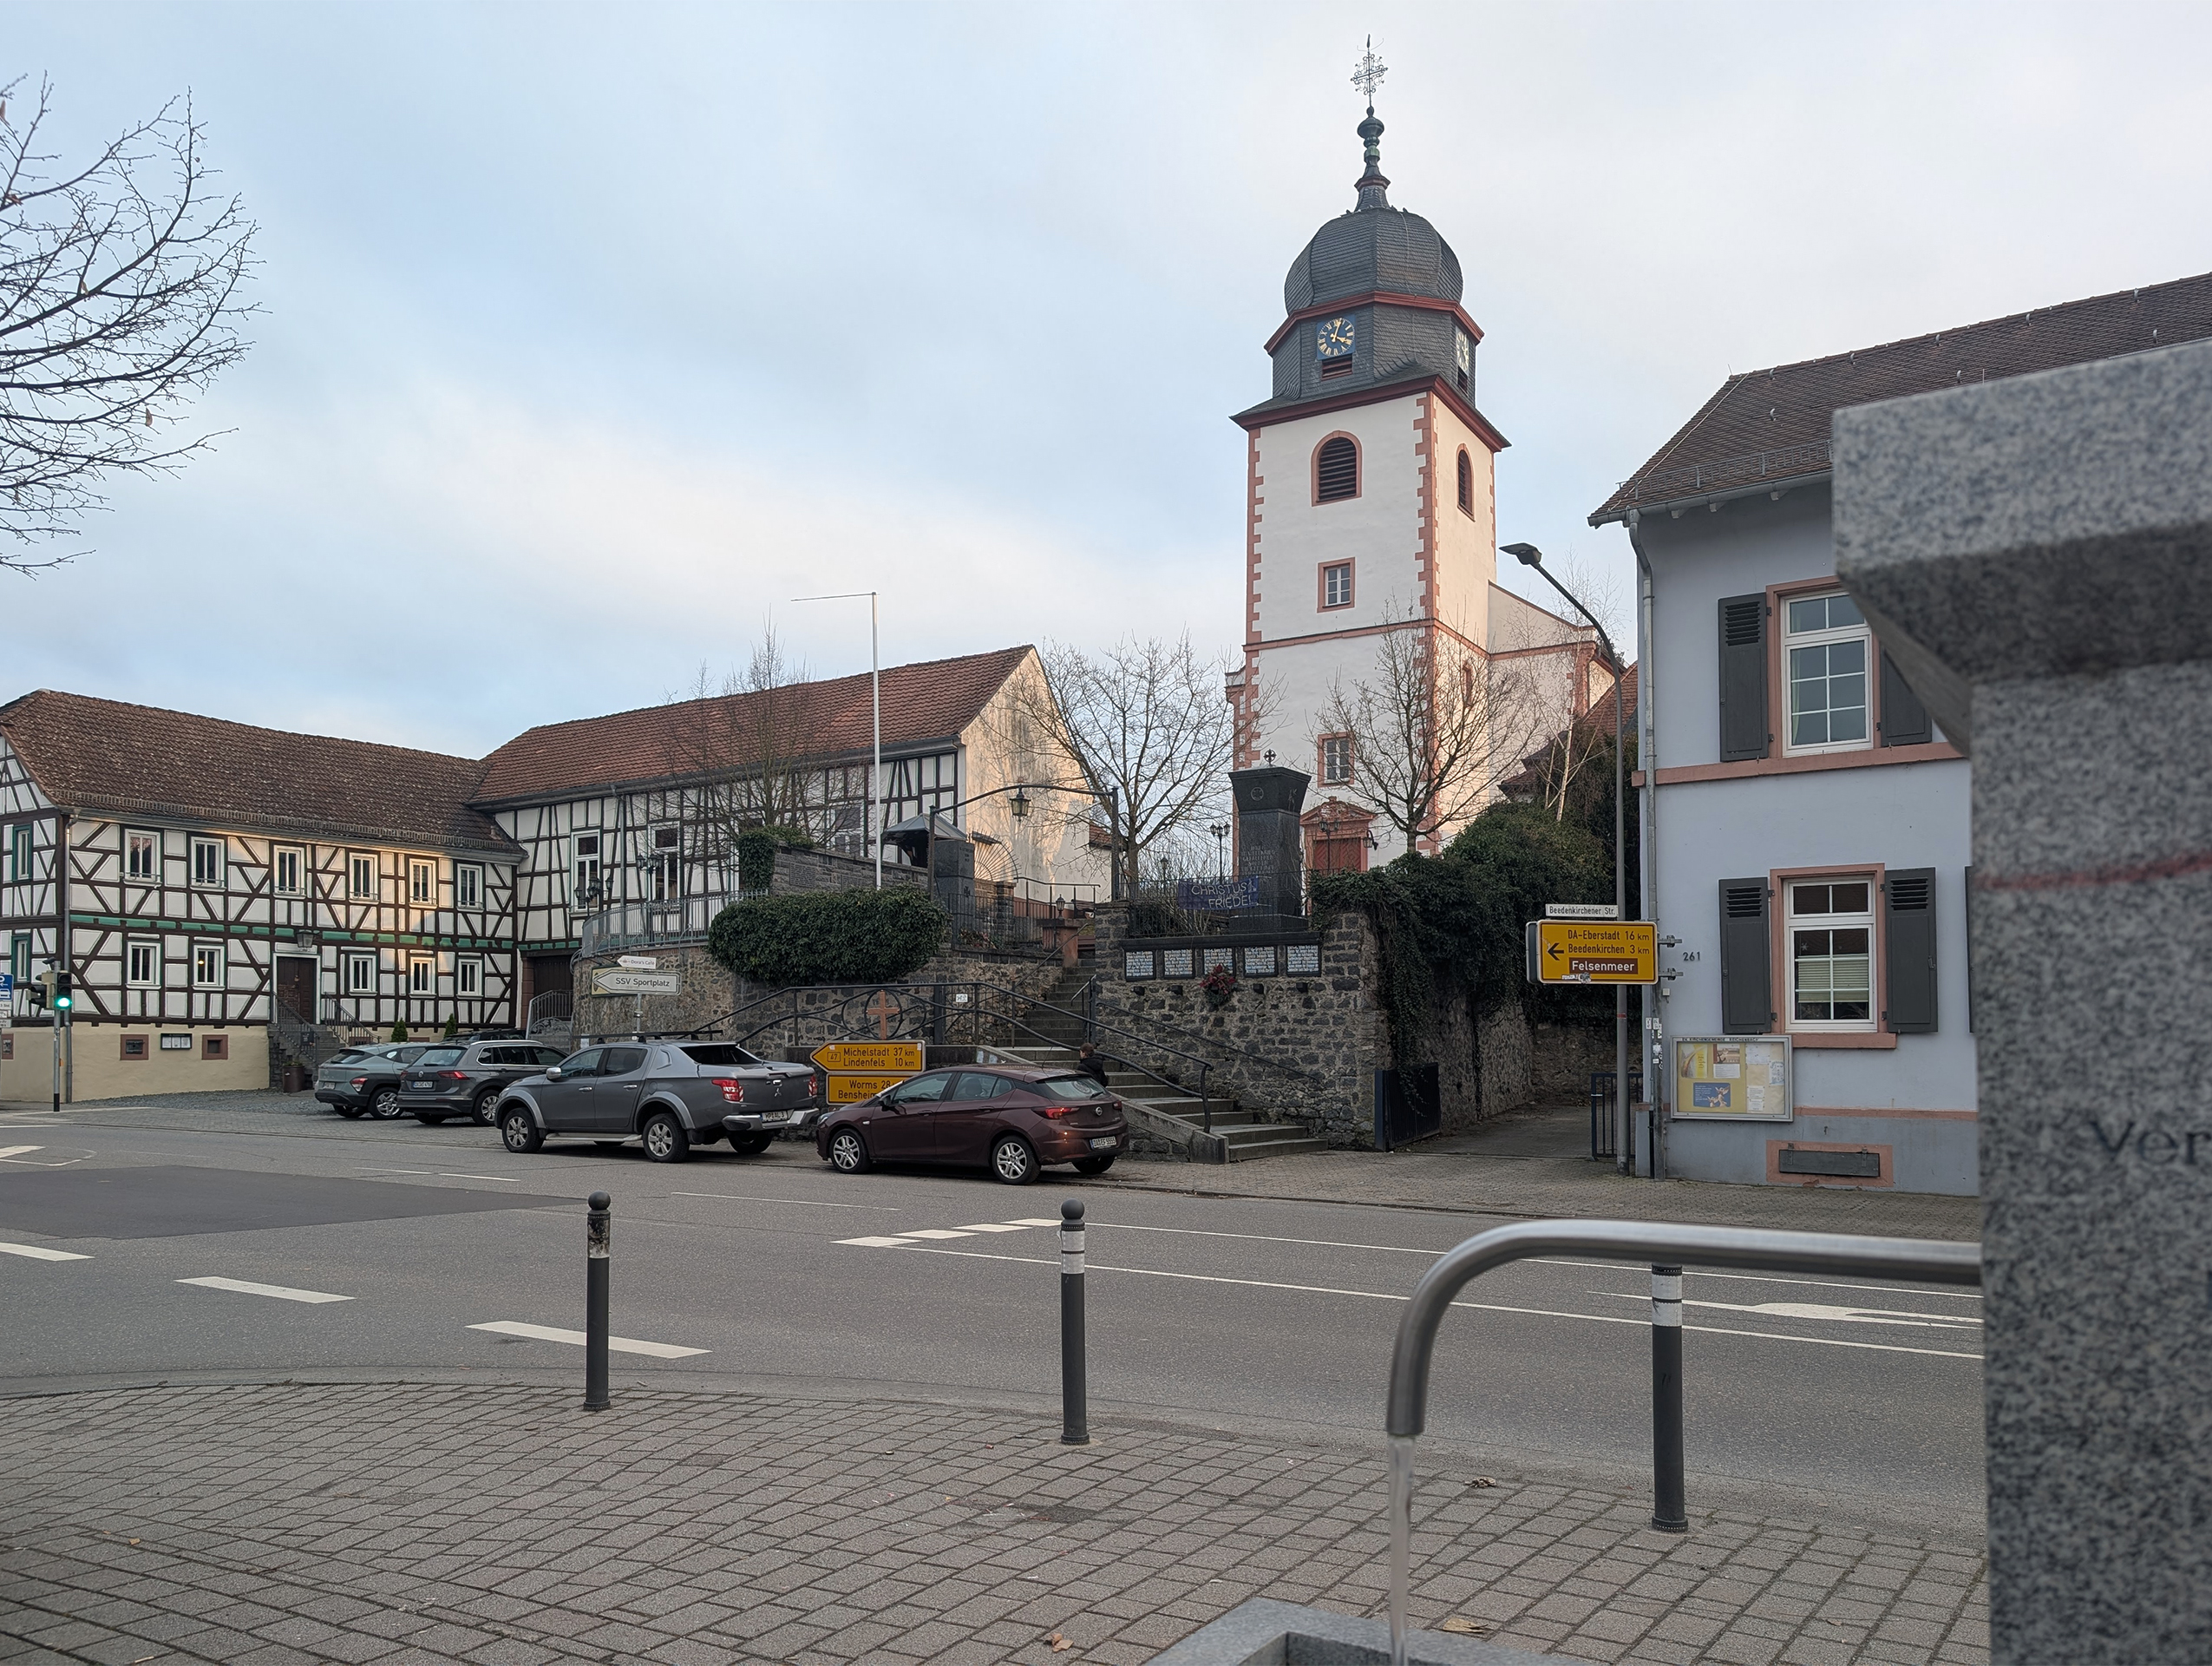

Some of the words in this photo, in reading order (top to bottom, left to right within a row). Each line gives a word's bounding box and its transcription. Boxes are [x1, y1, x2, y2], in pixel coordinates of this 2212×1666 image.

[1191, 882, 1247, 895] CHRISTUS
[1208, 895, 1251, 908] FRIEDE!
[1549, 906, 1602, 915] Beedenkirchener
[1604, 907, 1616, 915] Str.
[1567, 930, 1620, 941] DA-Eberstadt
[1625, 930, 1635, 941] 16
[1567, 943, 1625, 954] Beedenkirchen
[1629, 945, 1635, 954] 3
[1683, 952, 1701, 961] 261
[1572, 961, 1635, 972] Felsenmeer
[633, 978, 670, 987] Sportplatz
[843, 1047, 890, 1057] Michelstadt
[893, 1047, 903, 1056] 37
[843, 1058, 886, 1067] Lindenfels
[894, 1058, 904, 1066] 10
[849, 1079, 878, 1089] Worms
[880, 1080, 891, 1089] 28
